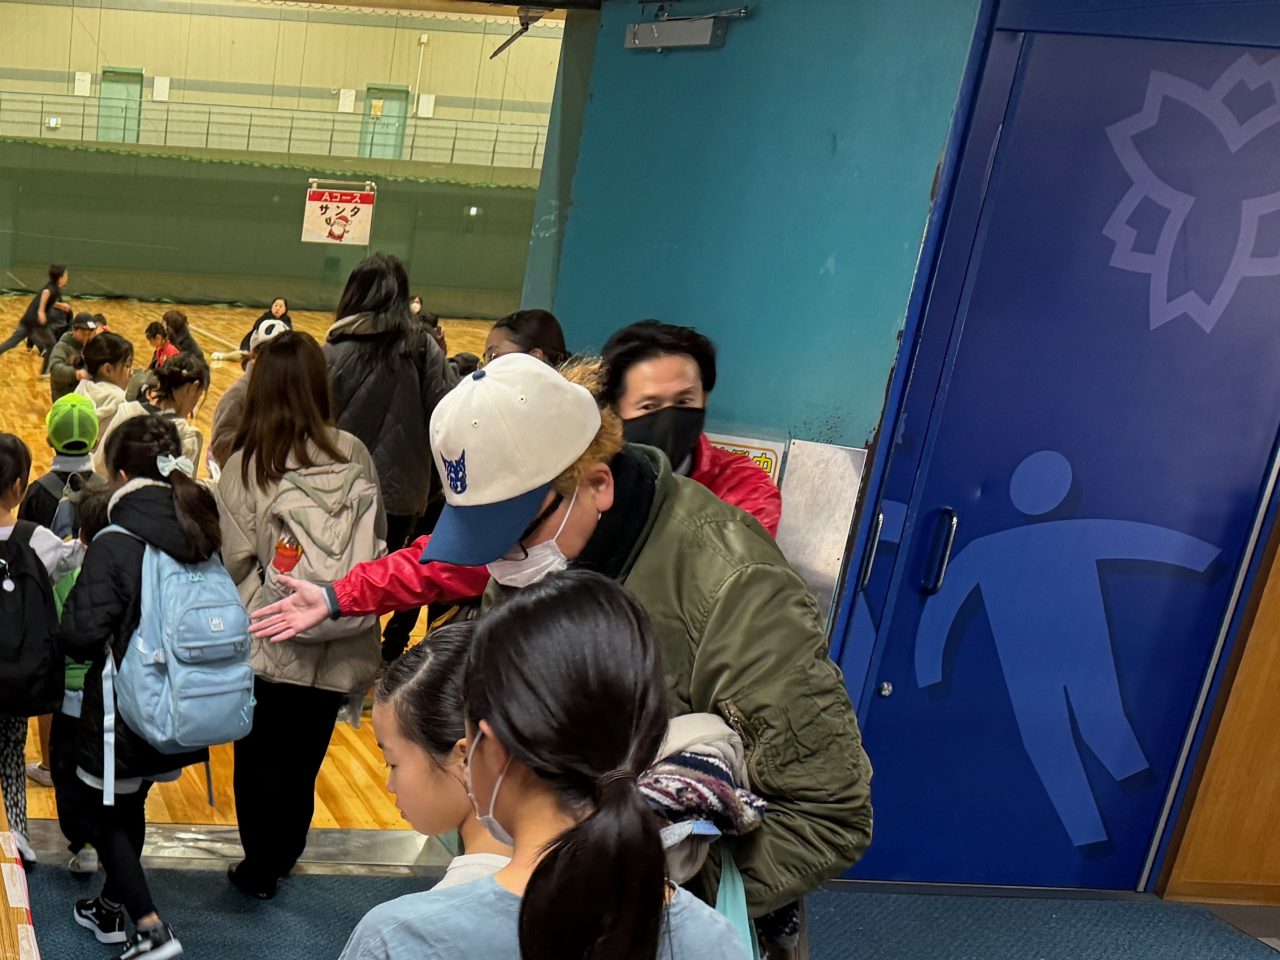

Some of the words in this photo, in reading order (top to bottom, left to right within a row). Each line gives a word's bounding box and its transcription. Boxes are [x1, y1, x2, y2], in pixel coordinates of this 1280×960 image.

[321, 192, 361, 203] Aコース
[319, 204, 361, 217] サンタ
